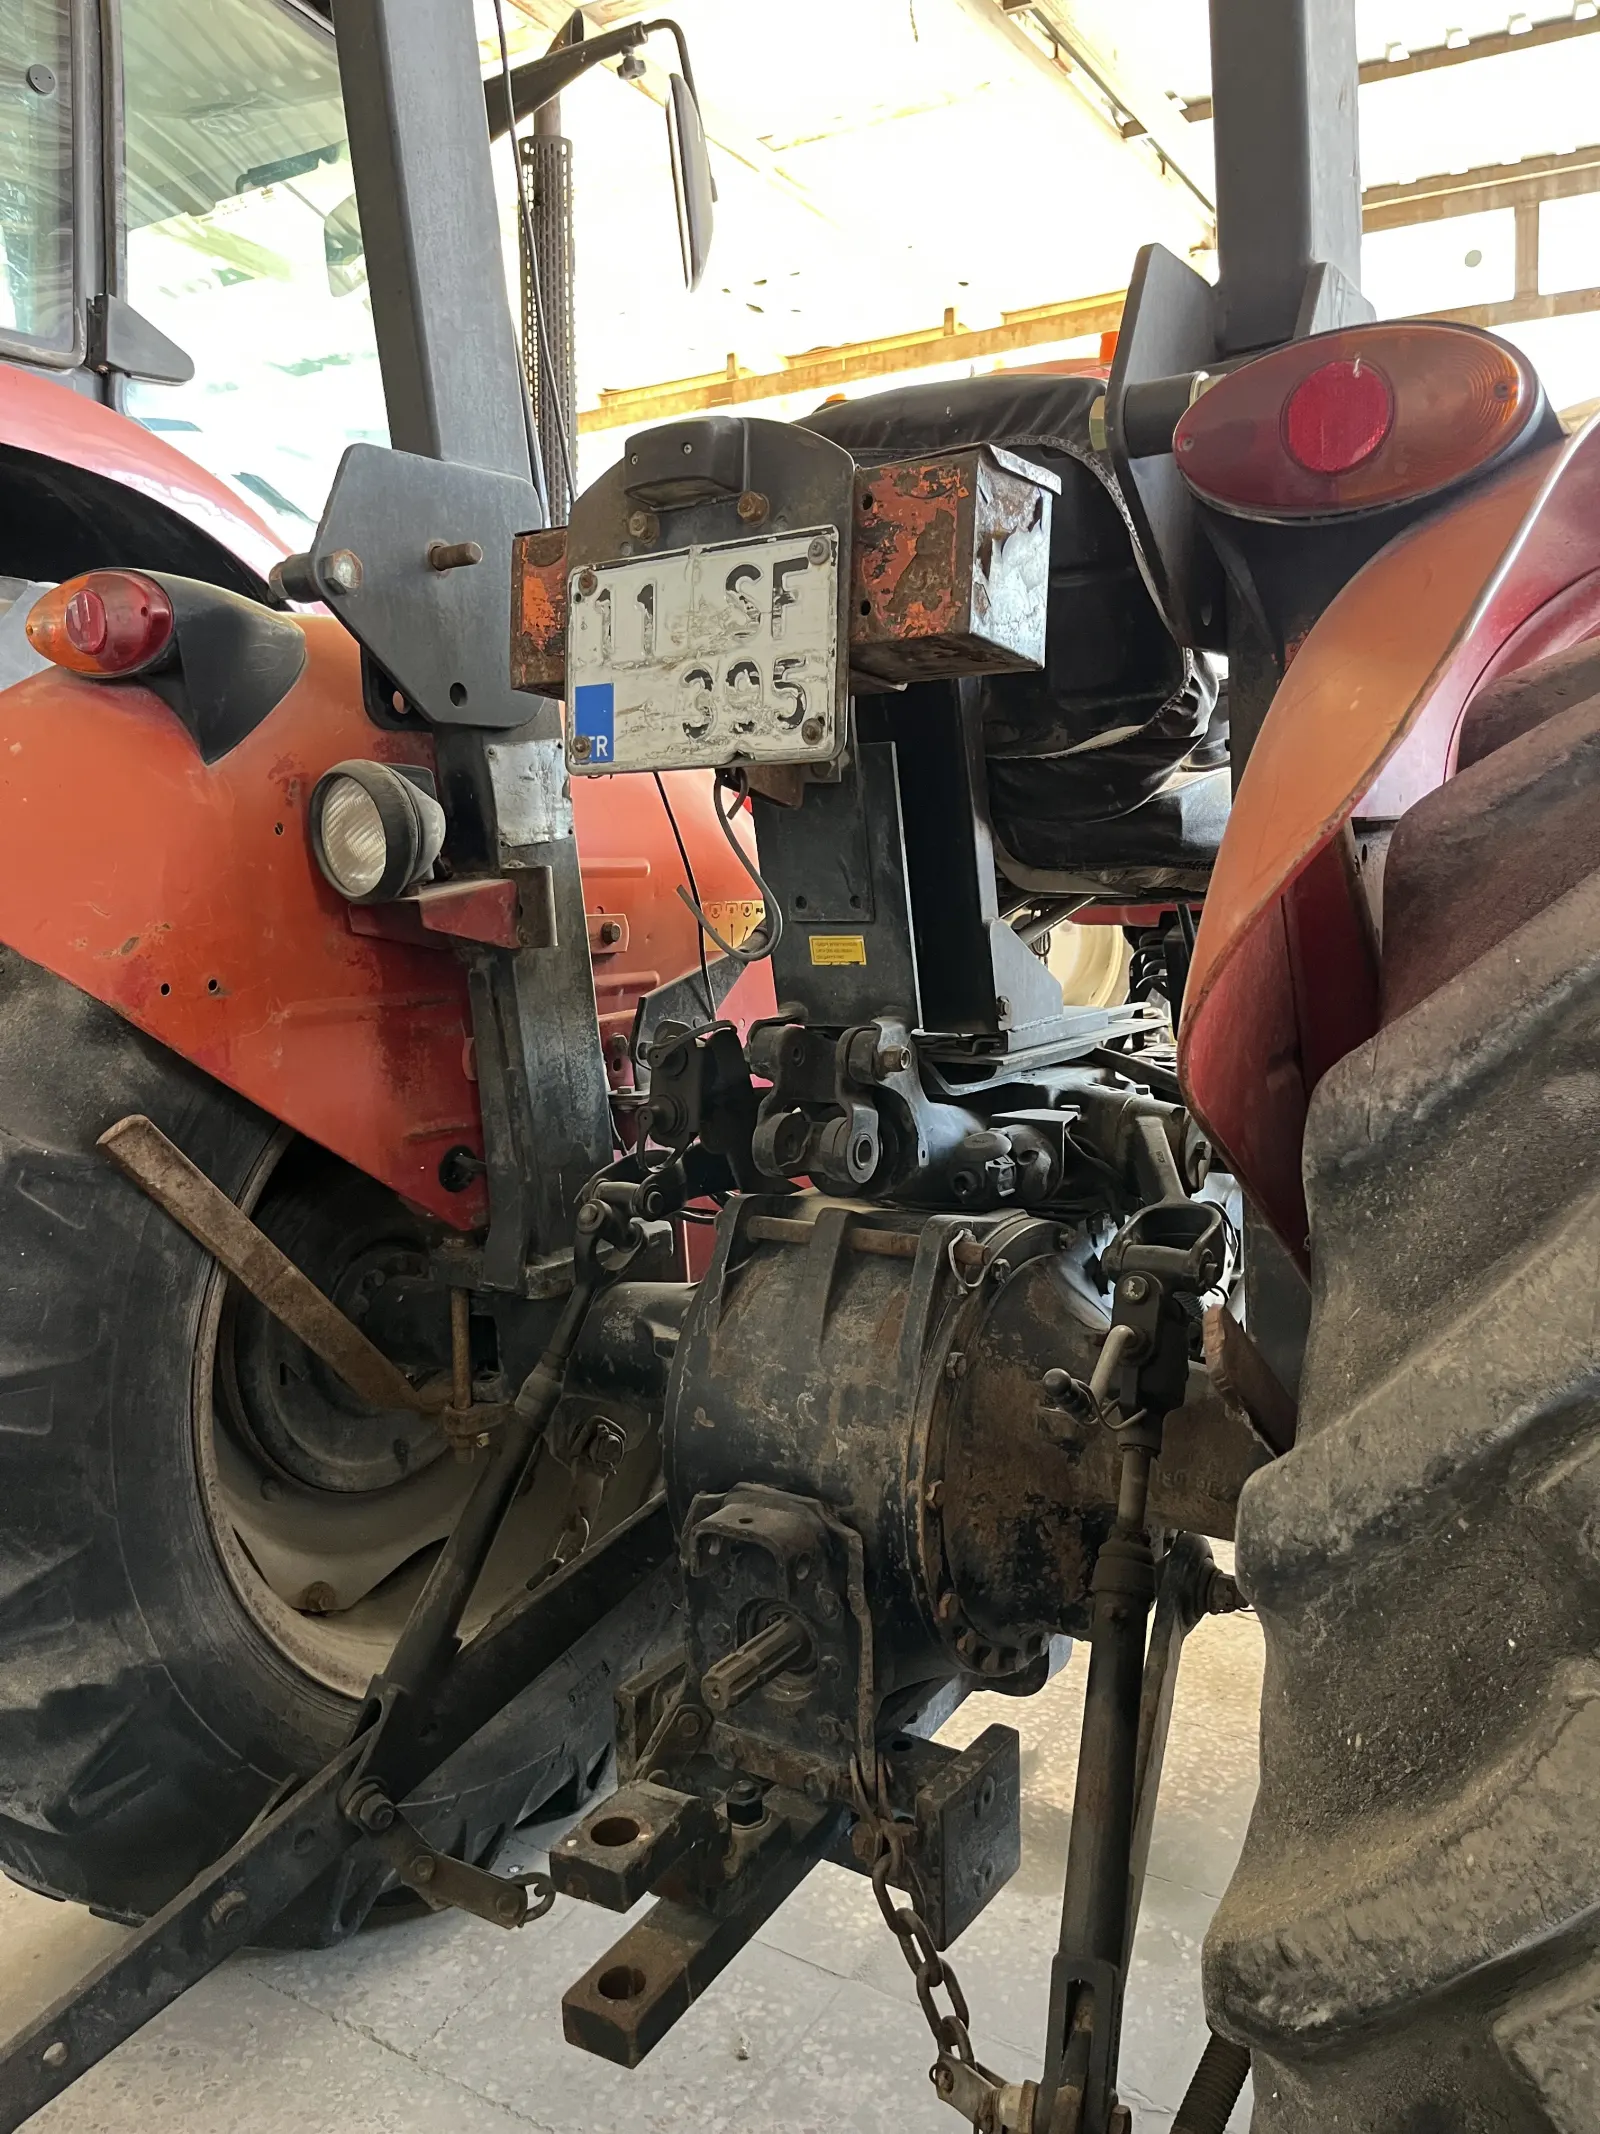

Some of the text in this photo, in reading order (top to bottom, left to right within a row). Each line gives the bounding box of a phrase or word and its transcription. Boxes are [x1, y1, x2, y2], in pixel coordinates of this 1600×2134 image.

[595, 557, 809, 665] 11 SF
[681, 658, 807, 740] 395
